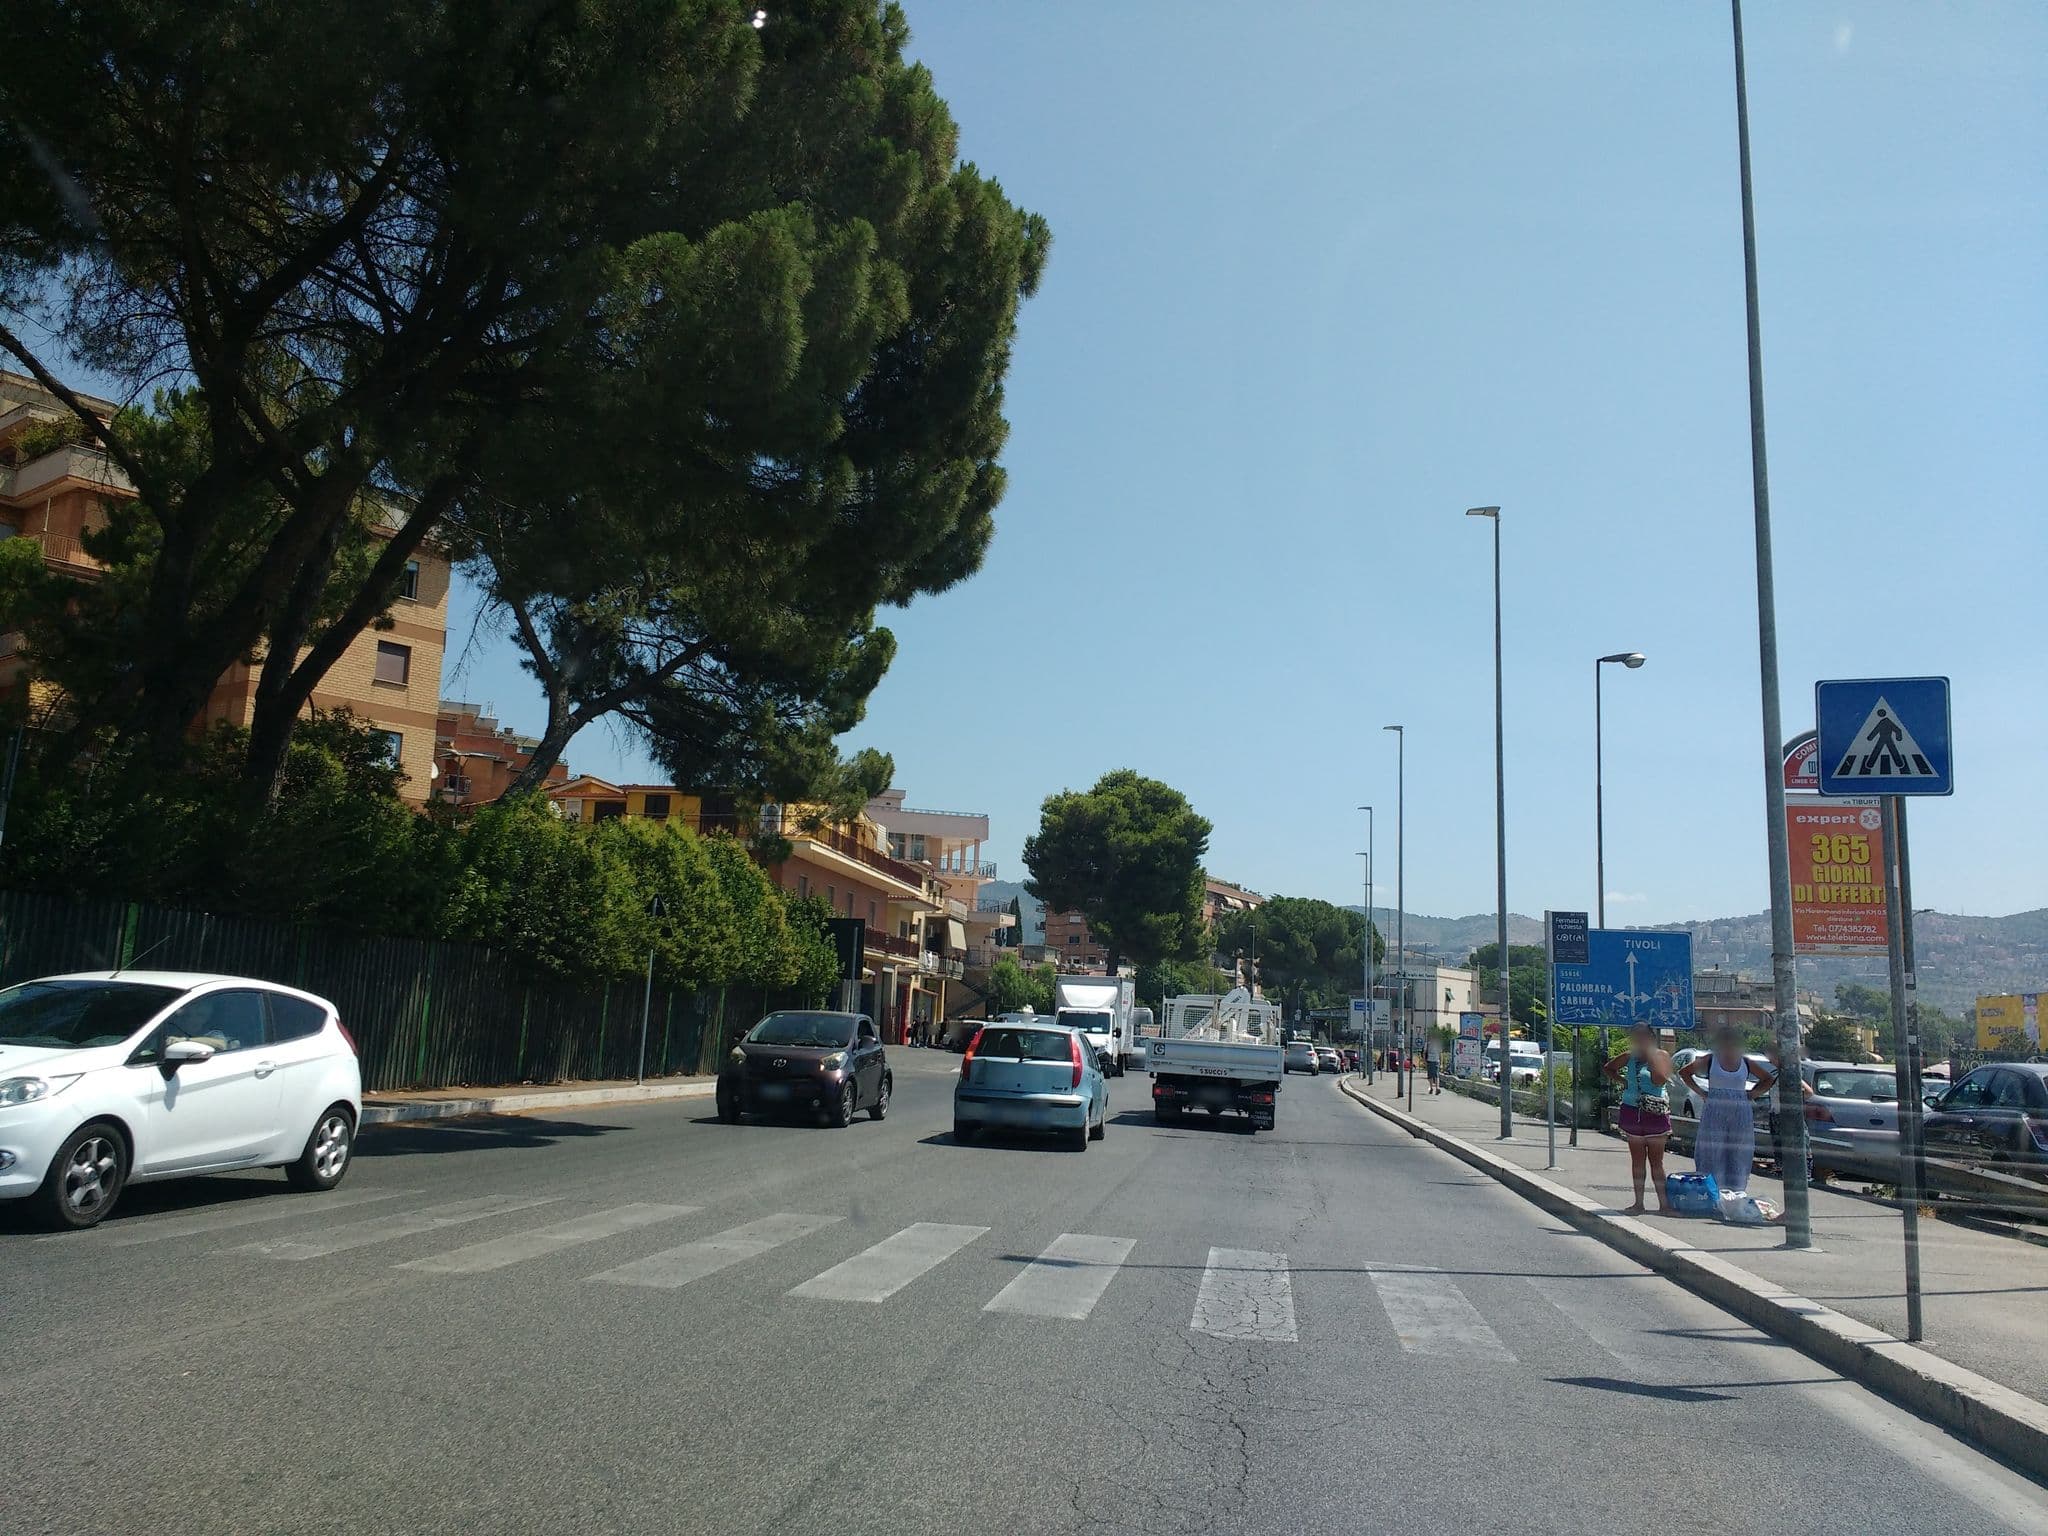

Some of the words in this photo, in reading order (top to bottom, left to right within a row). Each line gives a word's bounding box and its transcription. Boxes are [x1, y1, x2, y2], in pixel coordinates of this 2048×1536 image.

[1796, 814, 1856, 825] expert
[1811, 833, 1870, 864] 365
[1812, 865, 1872, 884] GIORNI
[1794, 884, 1814, 903] DI
[1556, 933, 1585, 942] cotral
[1806, 933, 1885, 942] www.telebuna.com
[1624, 939, 1661, 950] TIVOLI
[1560, 982, 1613, 994] PALOMBARA
[1560, 996, 1594, 1006] SABINA
